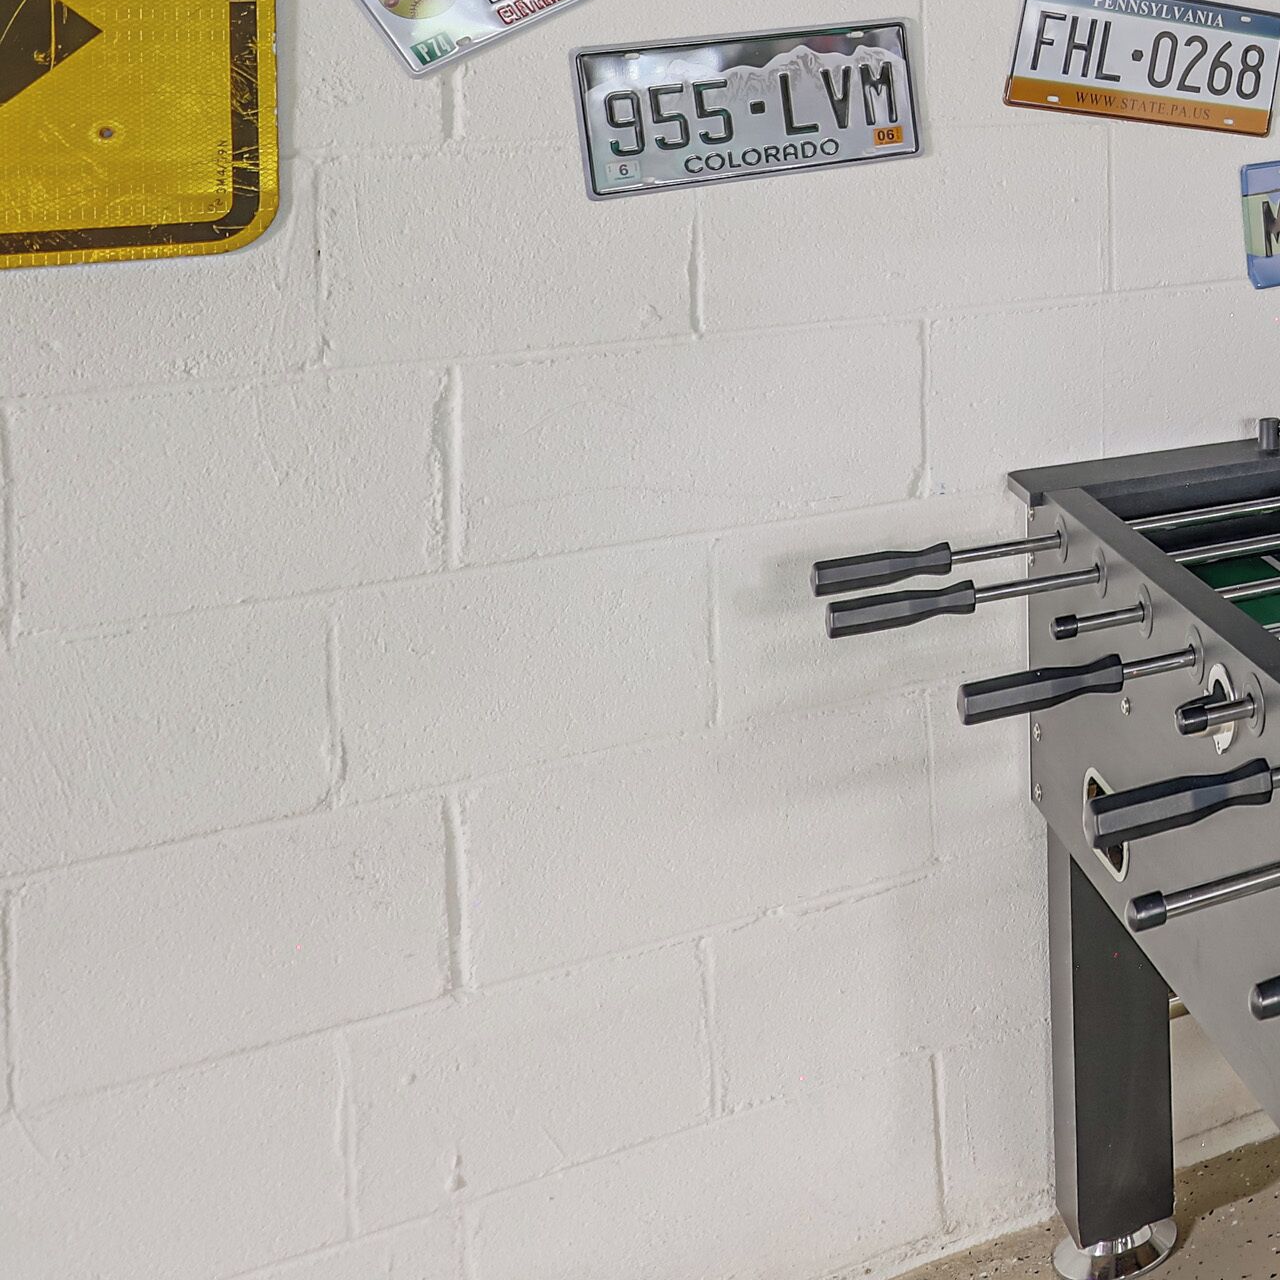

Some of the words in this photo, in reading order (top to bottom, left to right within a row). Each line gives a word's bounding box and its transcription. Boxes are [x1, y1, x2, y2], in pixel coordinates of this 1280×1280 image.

[1075, 90, 1211, 120] WWW.STATE.PA.US
[876, 126, 896, 143] 06
[683, 136, 841, 176] COLORADO
